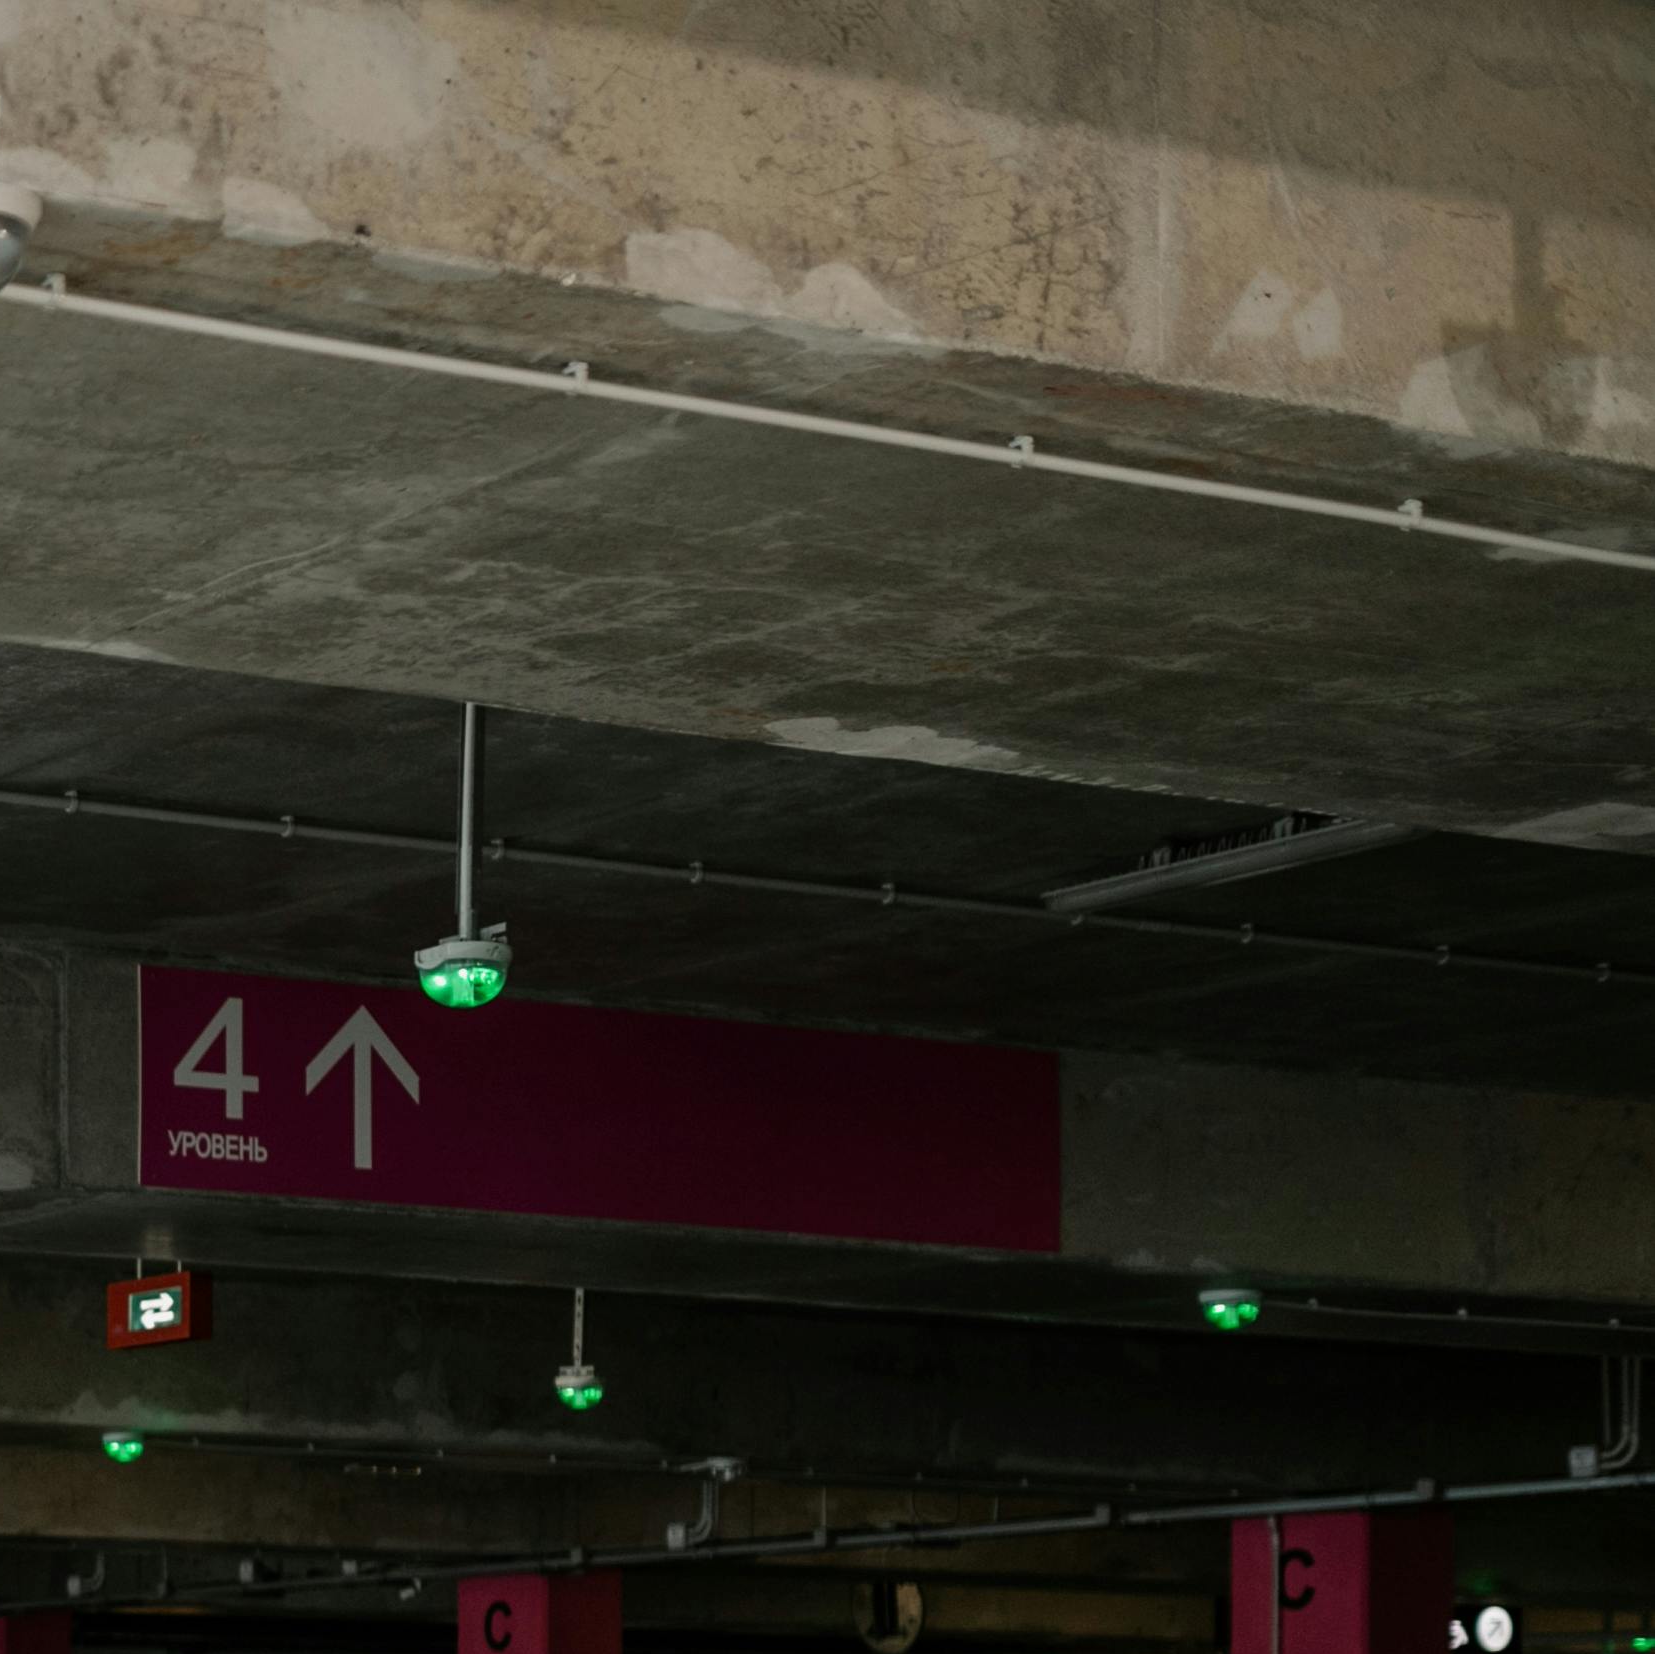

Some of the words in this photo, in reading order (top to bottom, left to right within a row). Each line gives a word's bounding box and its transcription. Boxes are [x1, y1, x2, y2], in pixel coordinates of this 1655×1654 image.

[173, 996, 259, 1119] 4
[167, 1129, 268, 1162] УРОВЕНЬ
[482, 1600, 515, 1653] C
